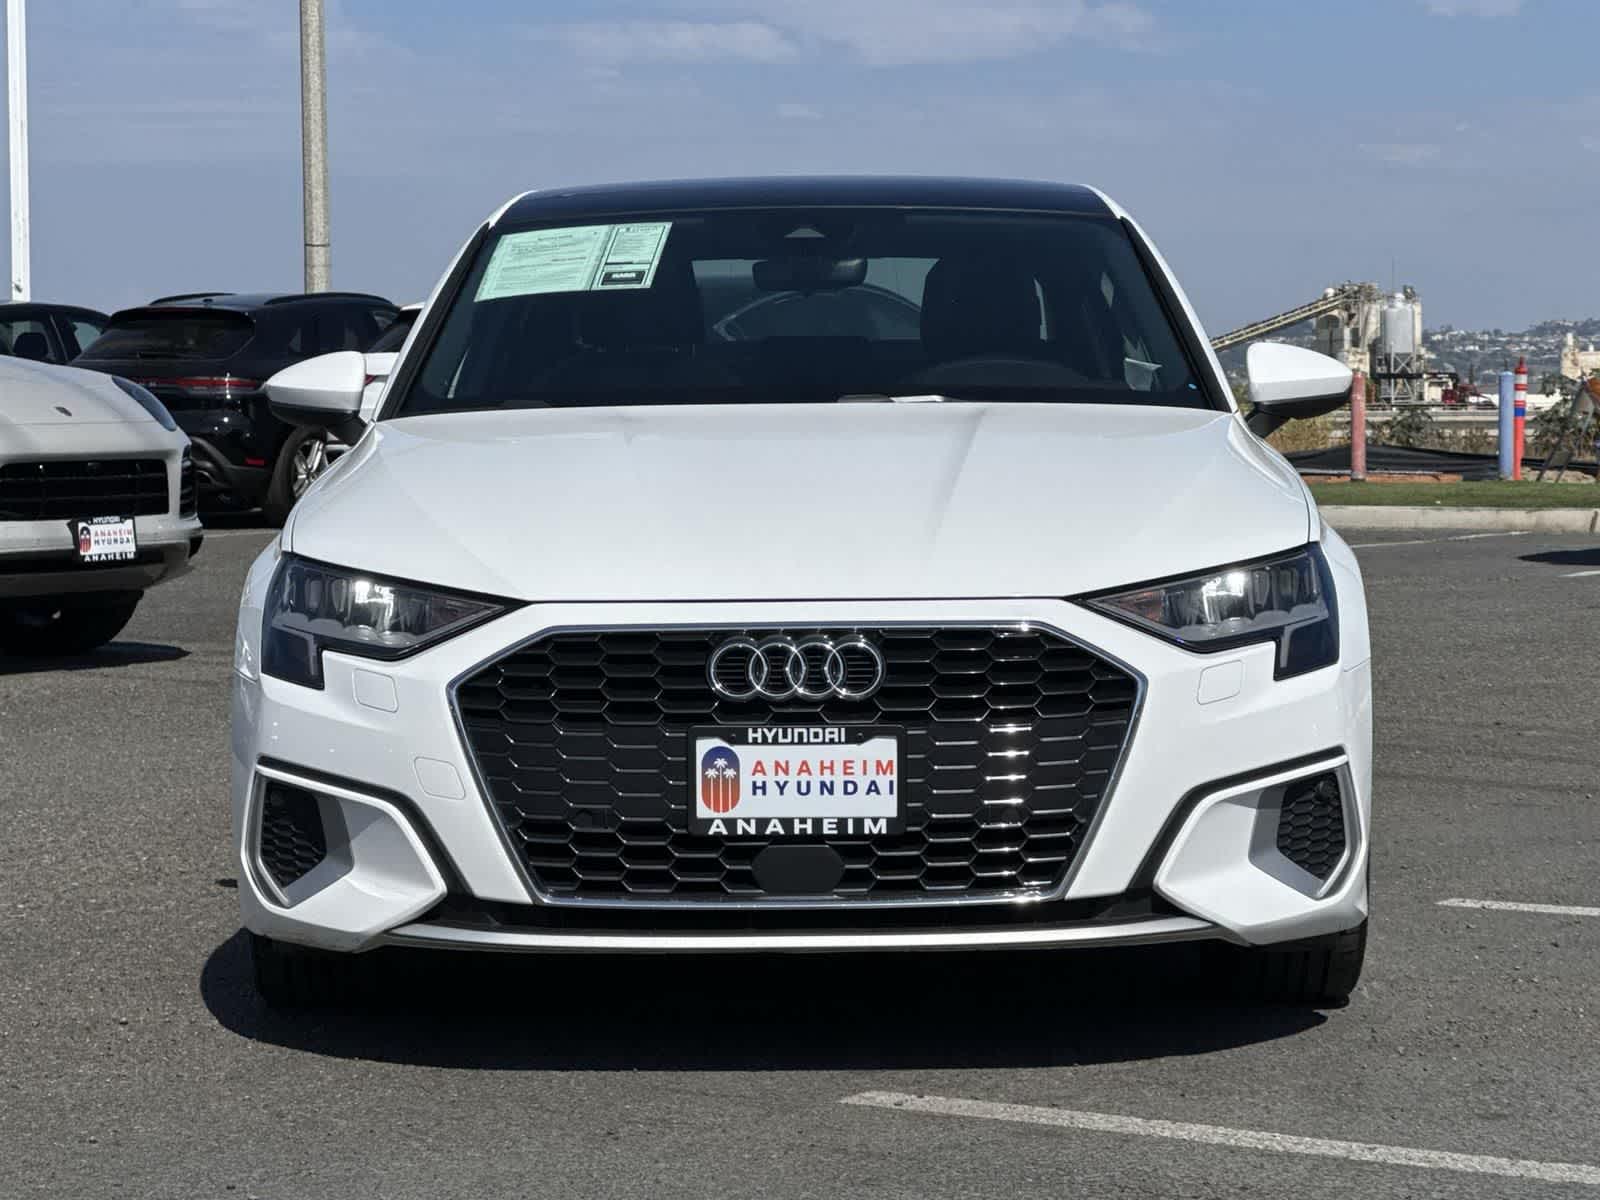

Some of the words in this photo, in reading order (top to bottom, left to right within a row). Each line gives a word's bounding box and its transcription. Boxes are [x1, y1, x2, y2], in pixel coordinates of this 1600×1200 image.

[84, 552, 134, 562] ANAHEIM
[747, 726, 846, 743] HYUNDAI
[751, 759, 894, 776] ANAHEIM
[751, 780, 894, 796] HYUNDAI
[708, 818, 887, 835] ANAHEIM
